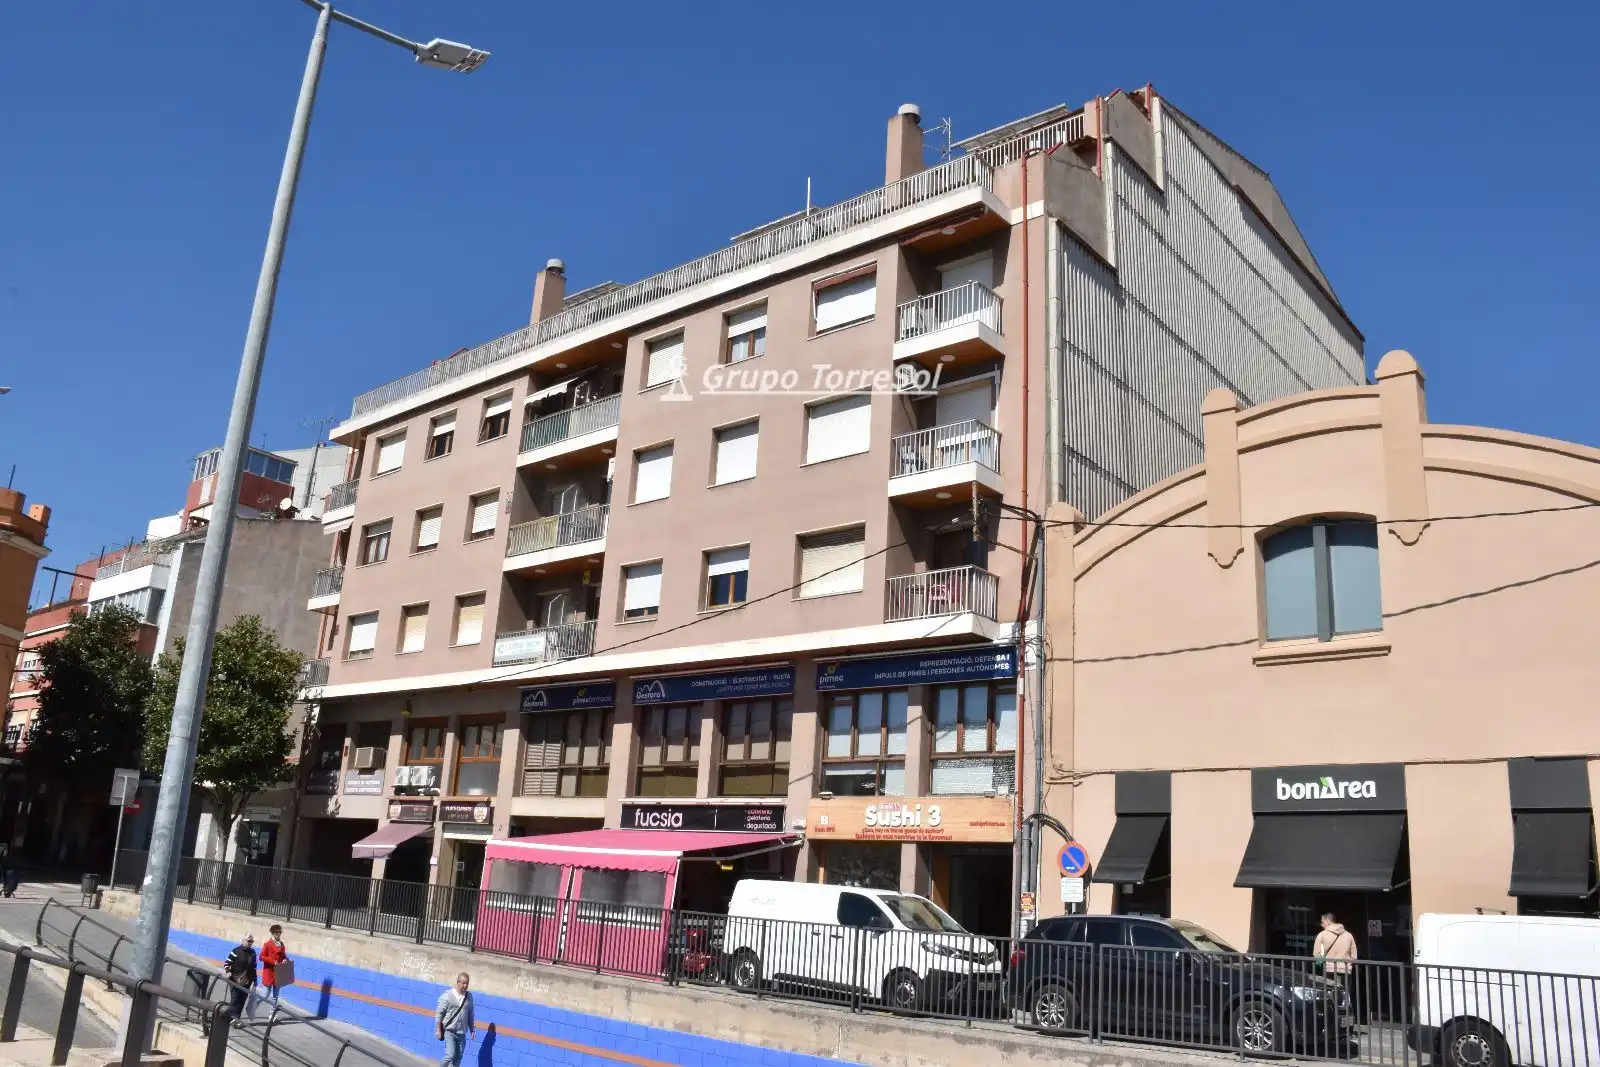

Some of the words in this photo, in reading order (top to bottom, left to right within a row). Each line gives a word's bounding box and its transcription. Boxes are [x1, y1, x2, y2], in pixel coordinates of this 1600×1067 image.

[974, 654, 1007, 663] DEFENSA
[874, 671, 897, 680] IMPULS
[897, 670, 907, 679] DE
[907, 668, 927, 678] PIMES
[930, 666, 966, 676] PERSONES
[634, 808, 683, 828] fucsia
[864, 803, 921, 828] Sushi
[927, 804, 942, 828] 3
